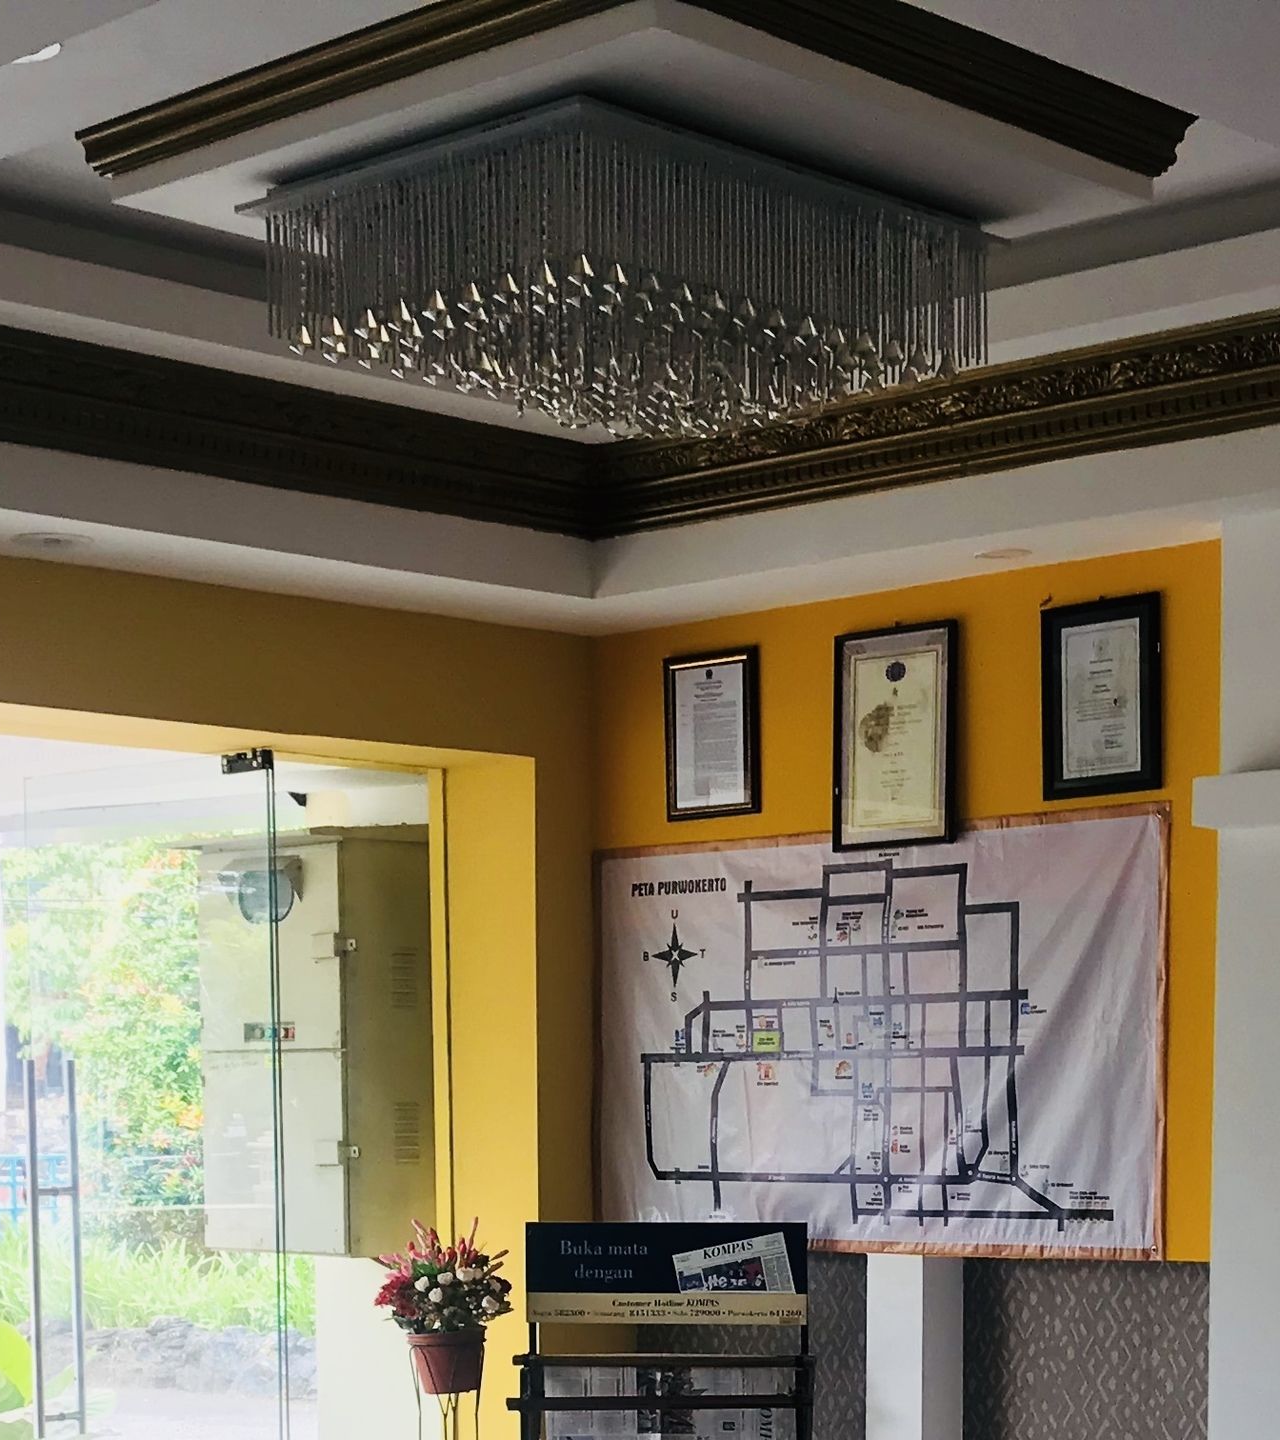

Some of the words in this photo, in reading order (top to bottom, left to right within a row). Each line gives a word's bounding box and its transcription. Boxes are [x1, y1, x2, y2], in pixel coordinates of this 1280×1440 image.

[631, 882, 655, 898] PETA
[658, 878, 727, 896] PURWOKERTO
[671, 909, 679, 920] U
[642, 952, 650, 962] B
[699, 949, 706, 959] T
[670, 992, 678, 1003] S
[559, 1239, 603, 1256] Buka
[608, 1242, 649, 1256] mata
[701, 1239, 754, 1261] KOMPAS
[574, 1264, 633, 1282] dengan
